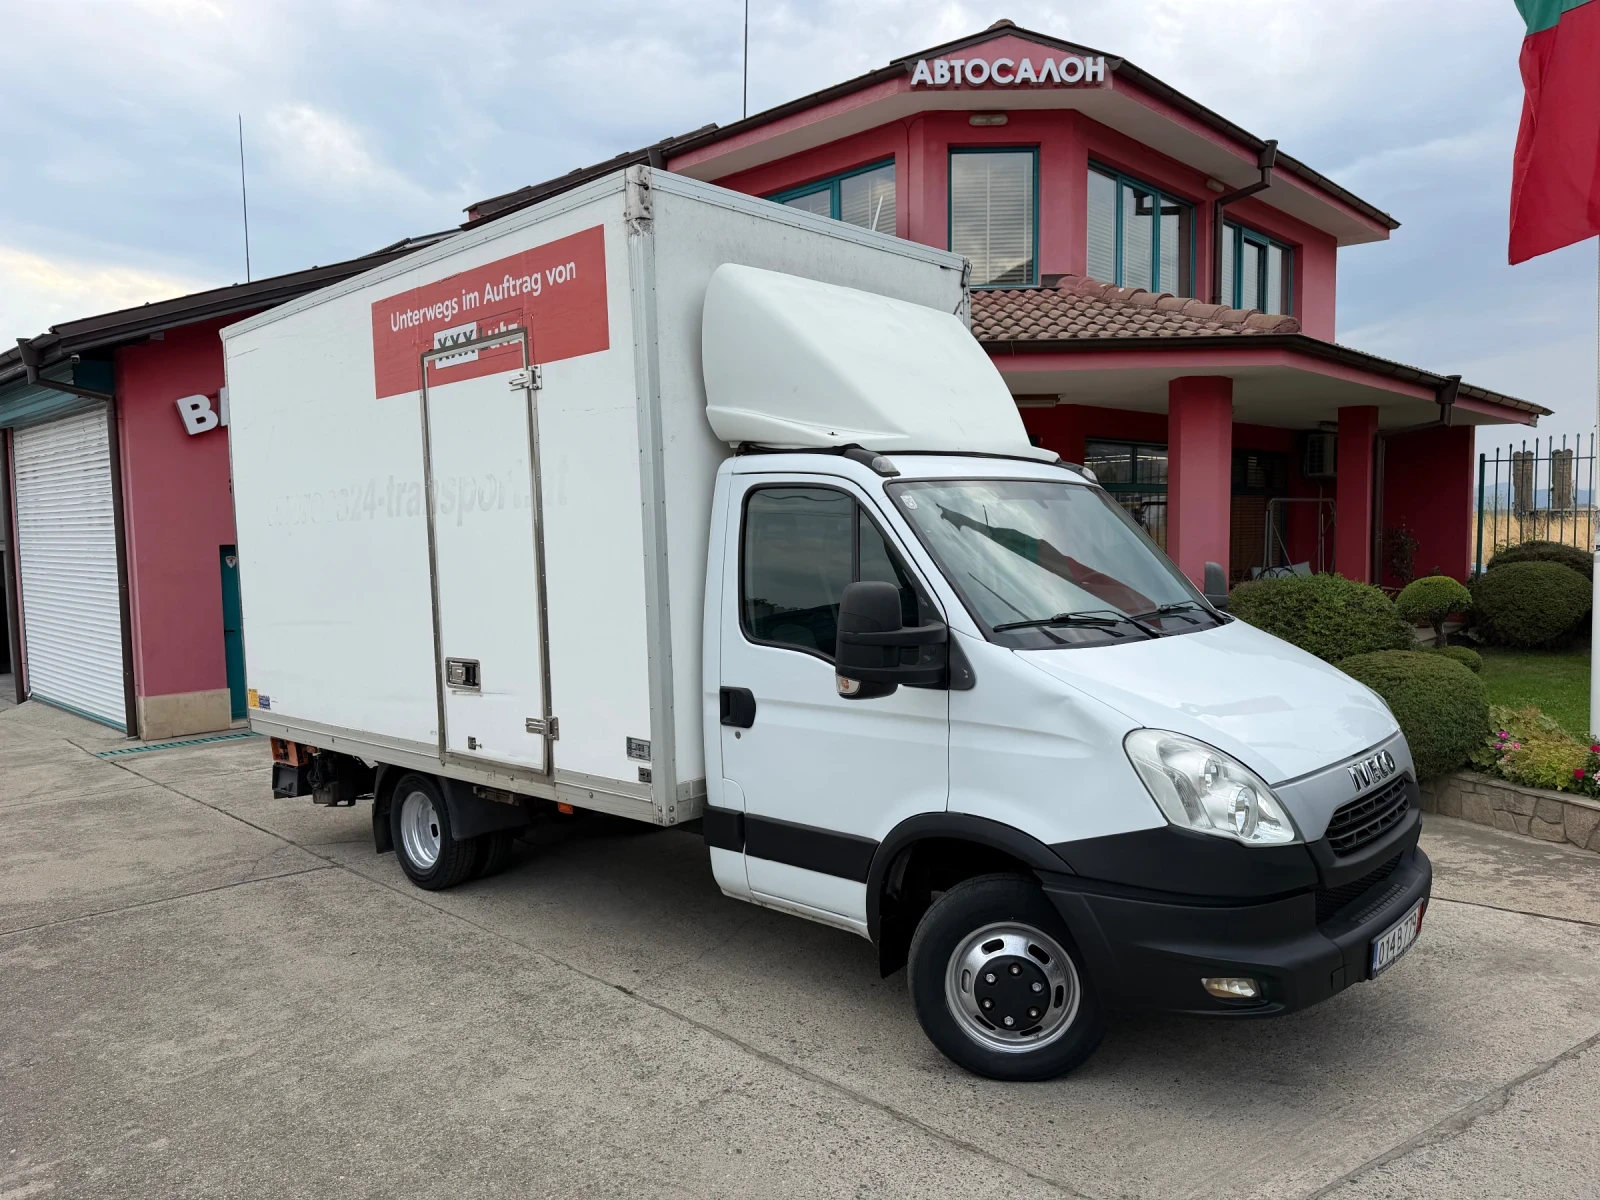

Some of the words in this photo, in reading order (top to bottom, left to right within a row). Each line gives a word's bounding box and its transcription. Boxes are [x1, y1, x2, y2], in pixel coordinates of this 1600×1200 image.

[910, 56, 1105, 85] АВТОСАЛОН
[390, 298, 458, 332] Unterwegs
[462, 289, 480, 311] im
[483, 271, 542, 305] Auftrag
[545, 261, 576, 286] von
[1347, 749, 1395, 792] IVECO
